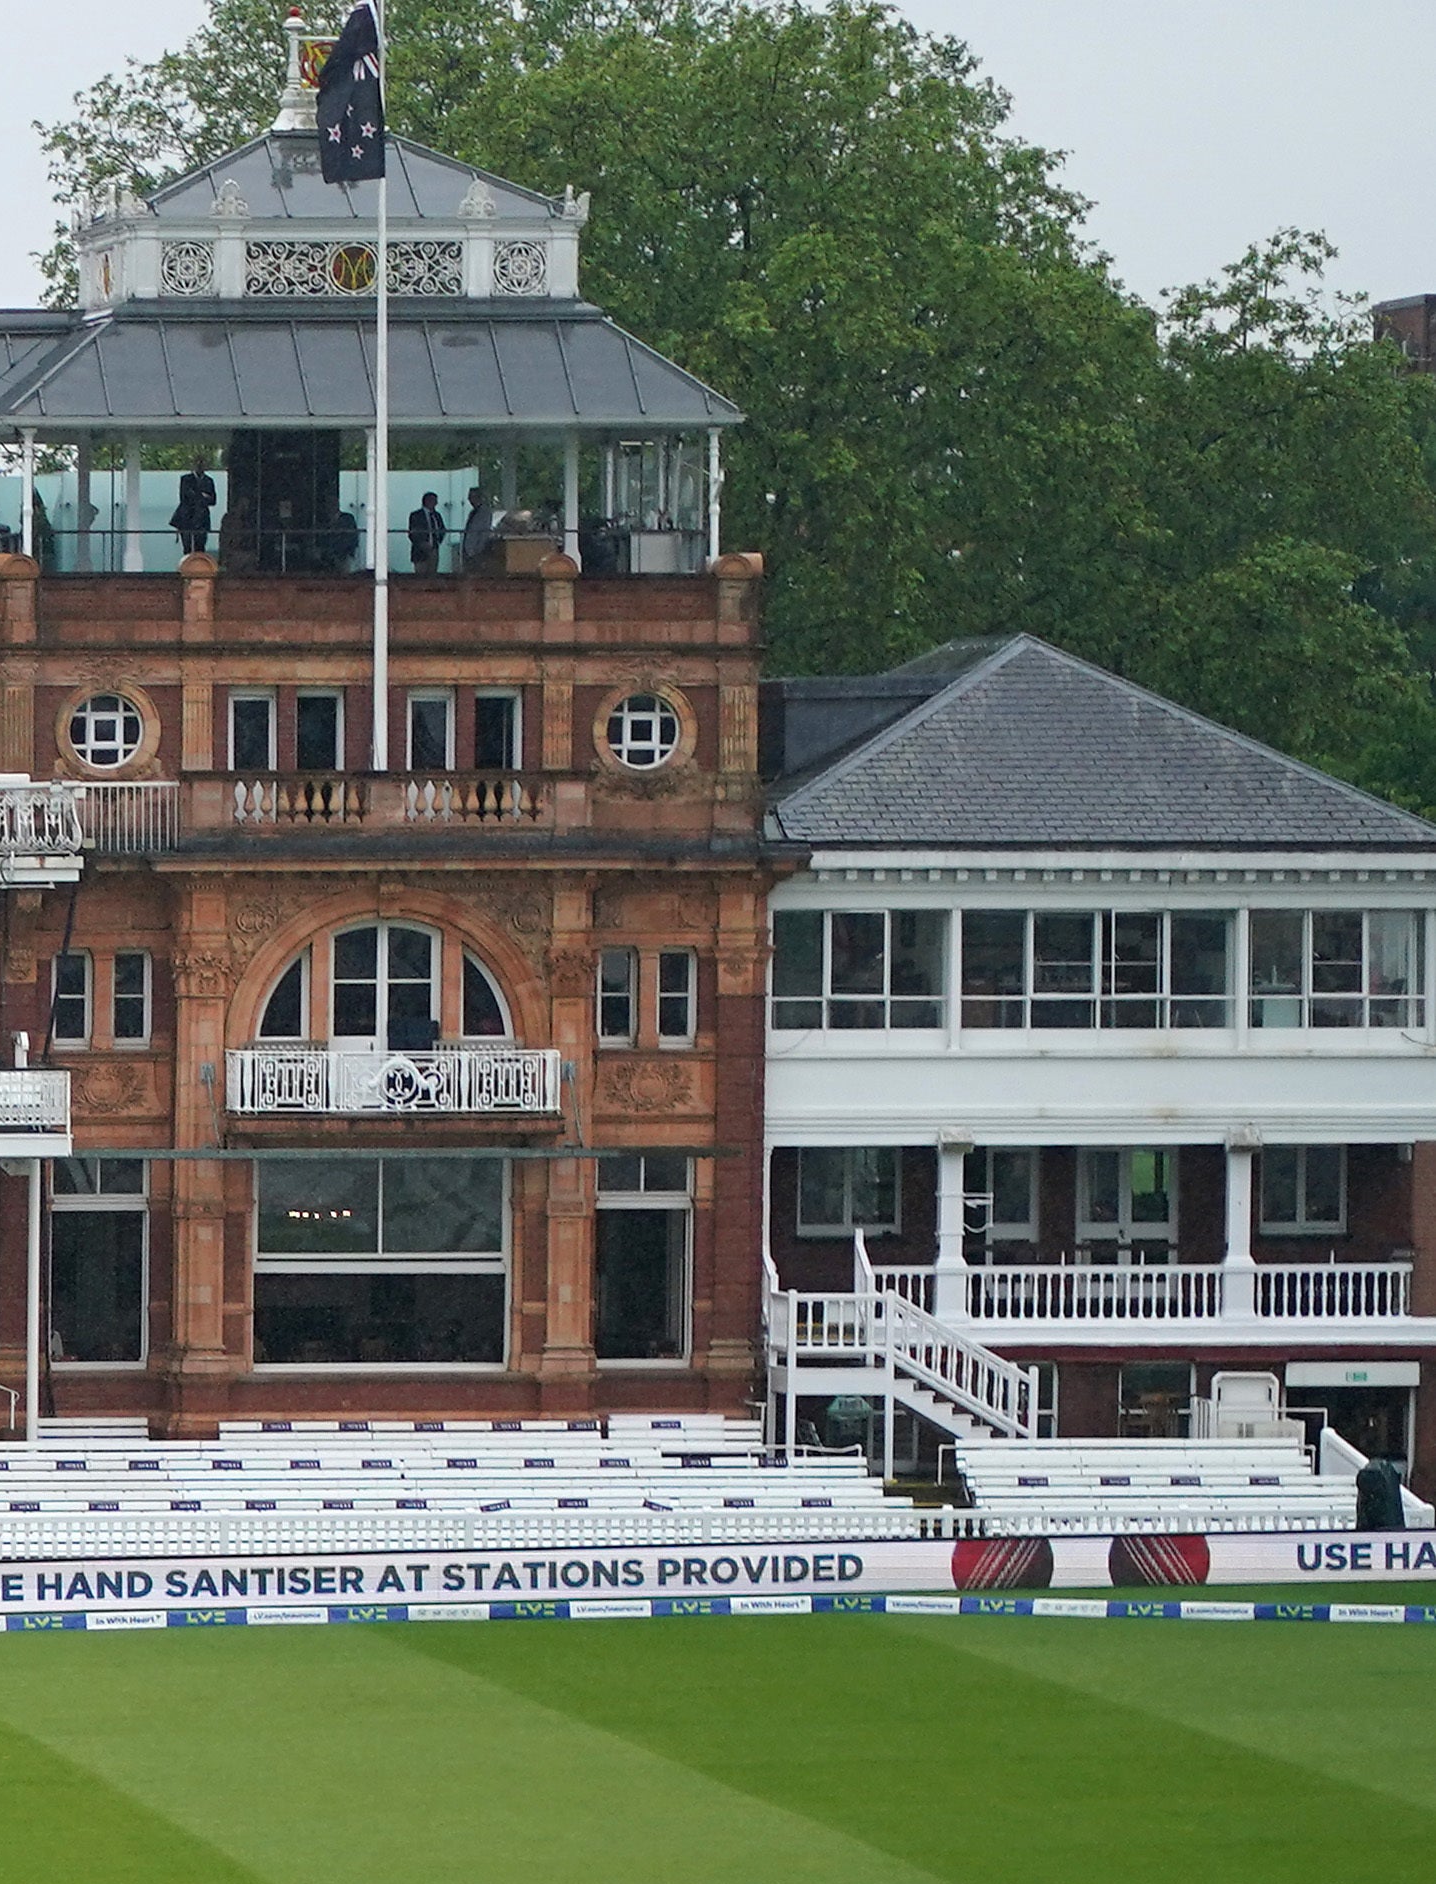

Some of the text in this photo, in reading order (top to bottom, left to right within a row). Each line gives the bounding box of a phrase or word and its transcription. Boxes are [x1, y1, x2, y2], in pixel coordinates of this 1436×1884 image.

[1297, 1542, 1372, 1570] USE
[37, 1570, 153, 1601] HAND
[165, 1566, 364, 1598] SANTISER
[377, 1563, 430, 1593] AT
[442, 1558, 644, 1591] STATIONS
[657, 1554, 864, 1586] PROVIDED
